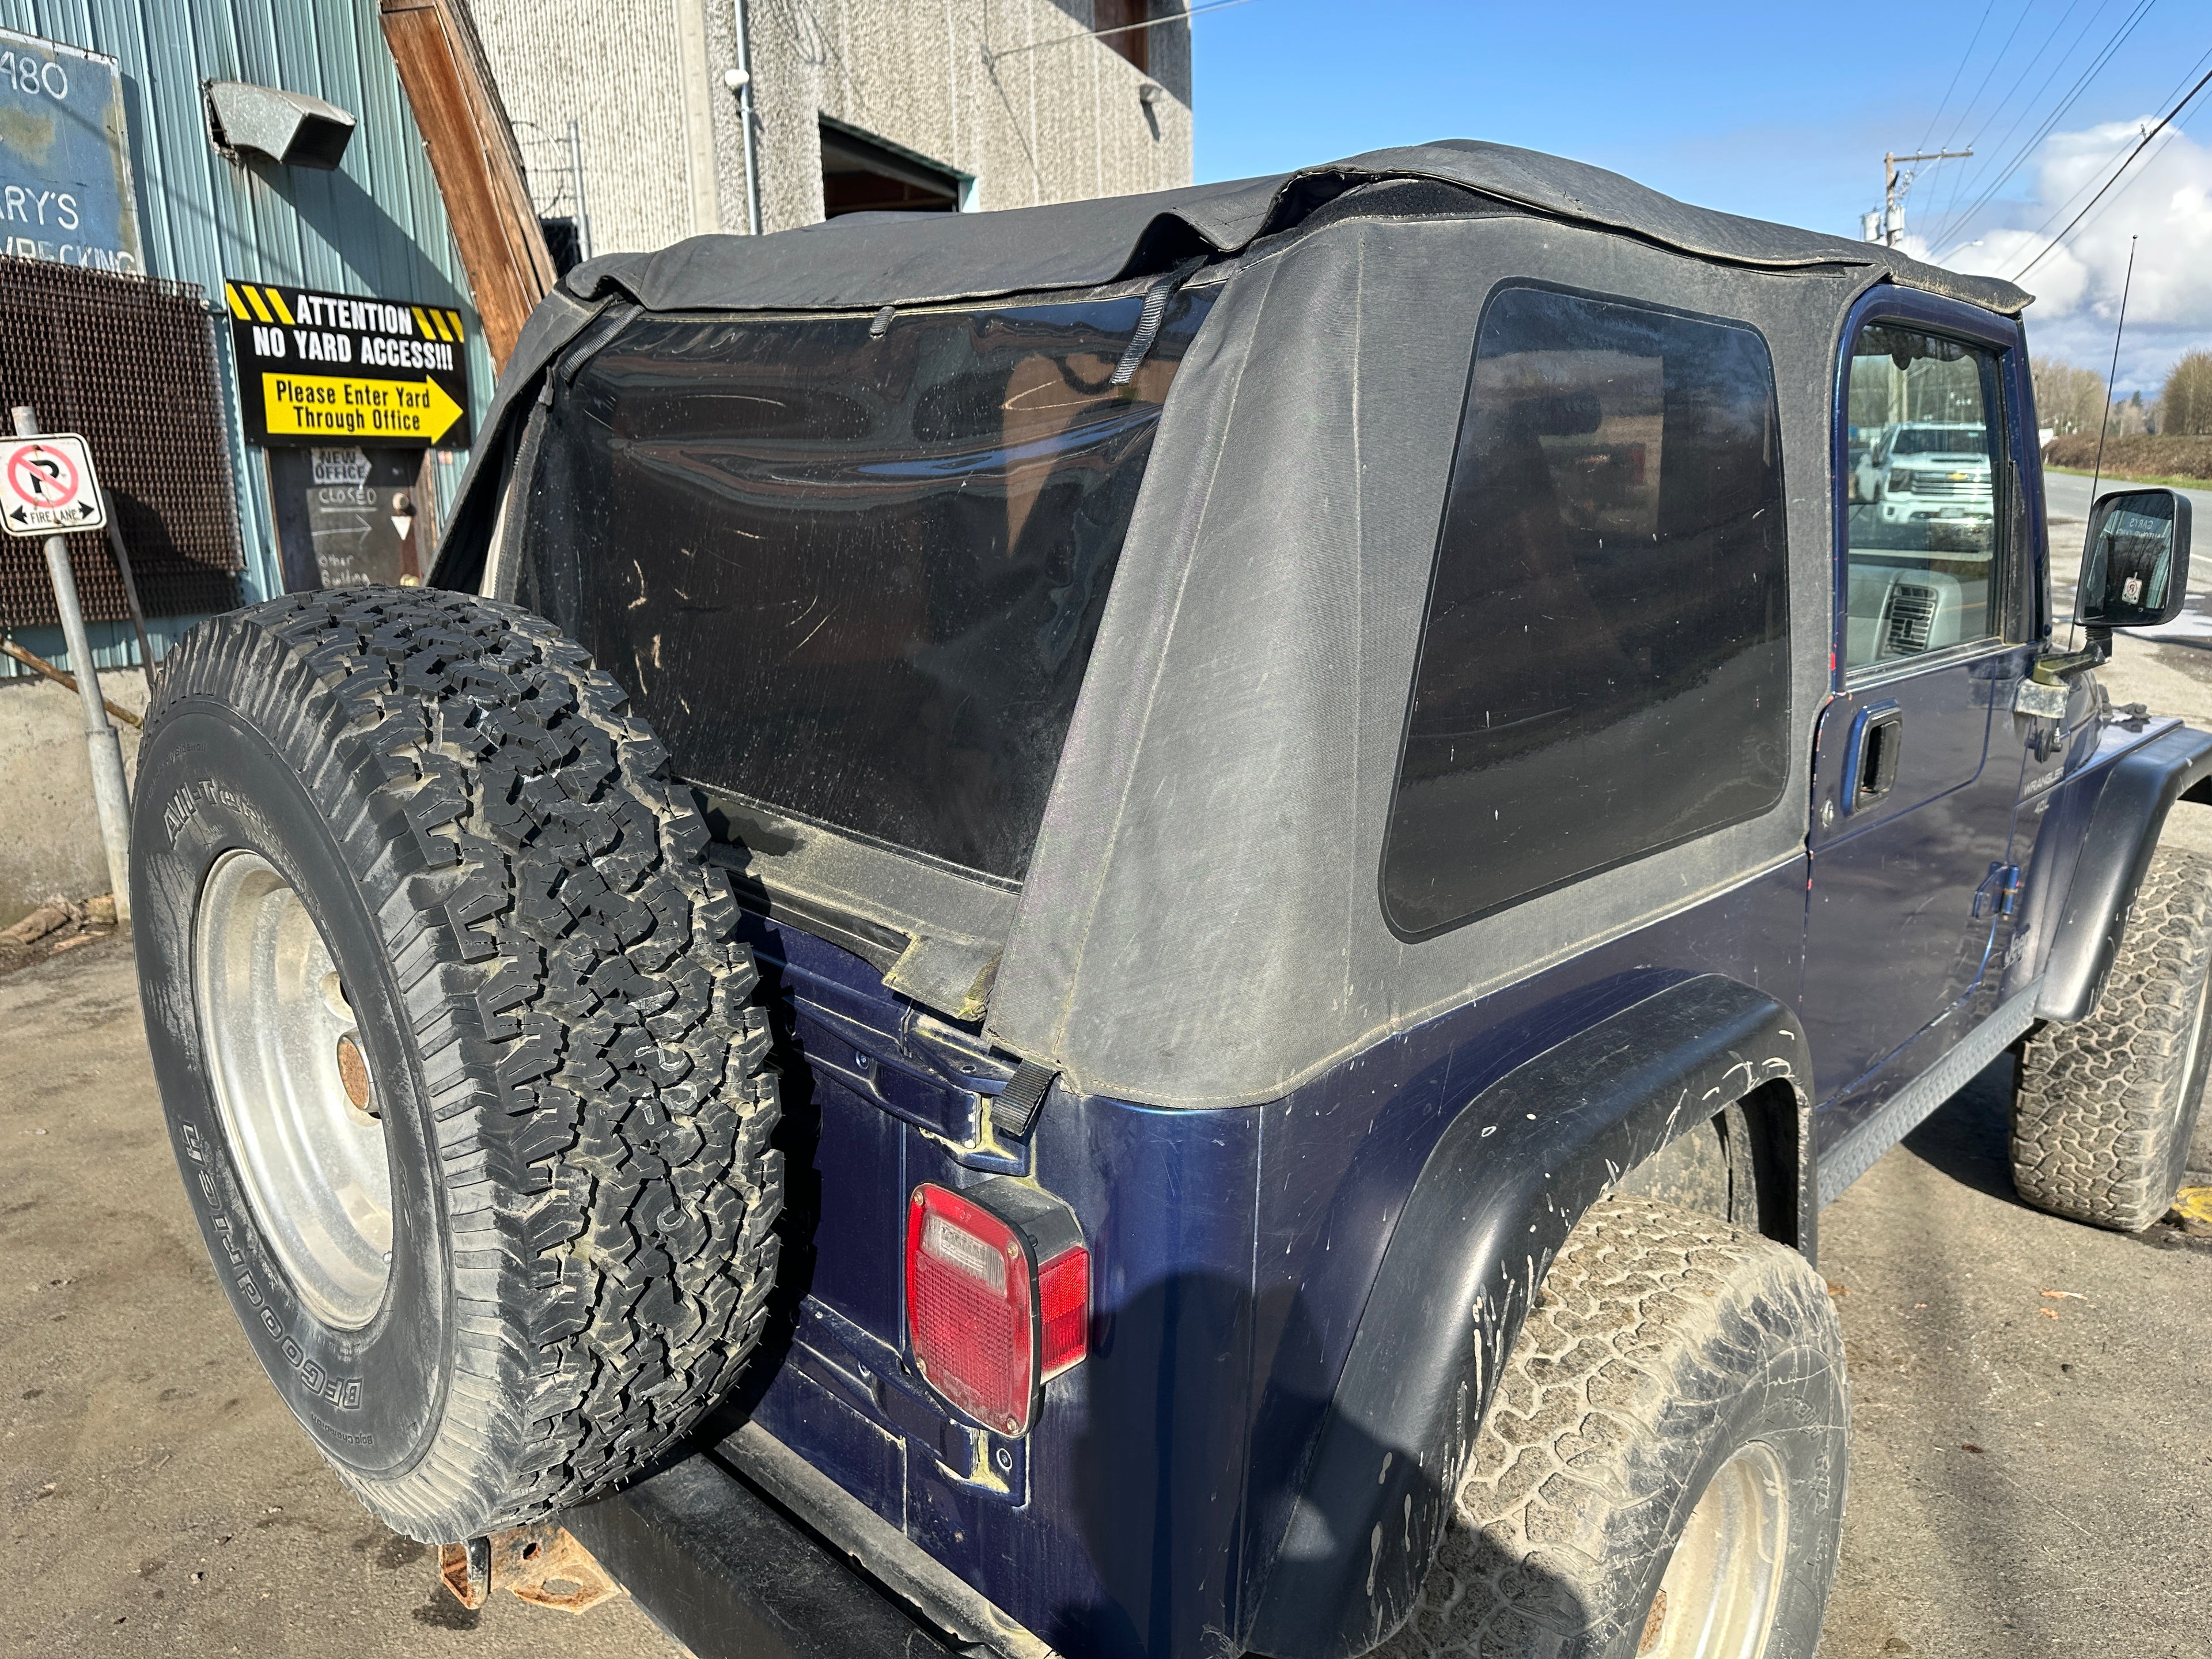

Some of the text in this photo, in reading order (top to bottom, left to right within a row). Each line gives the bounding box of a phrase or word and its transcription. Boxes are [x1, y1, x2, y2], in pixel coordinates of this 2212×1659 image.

[0, 185, 79, 230] RY'S
[297, 294, 413, 336] ATTENTION
[252, 325, 454, 371] NO YARD ACCESS!!!
[276, 380, 430, 408] Please Enter Yard
[293, 406, 421, 433] Through Office
[315, 463, 366, 480] OFFICE
[320, 450, 355, 464] NEW
[30, 511, 52, 524] FIRE
[2024, 766, 2065, 796] WRANGLER
[182, 1121, 363, 1410] BFGoodrich
[311, 1414, 373, 1445] Baja Champion
